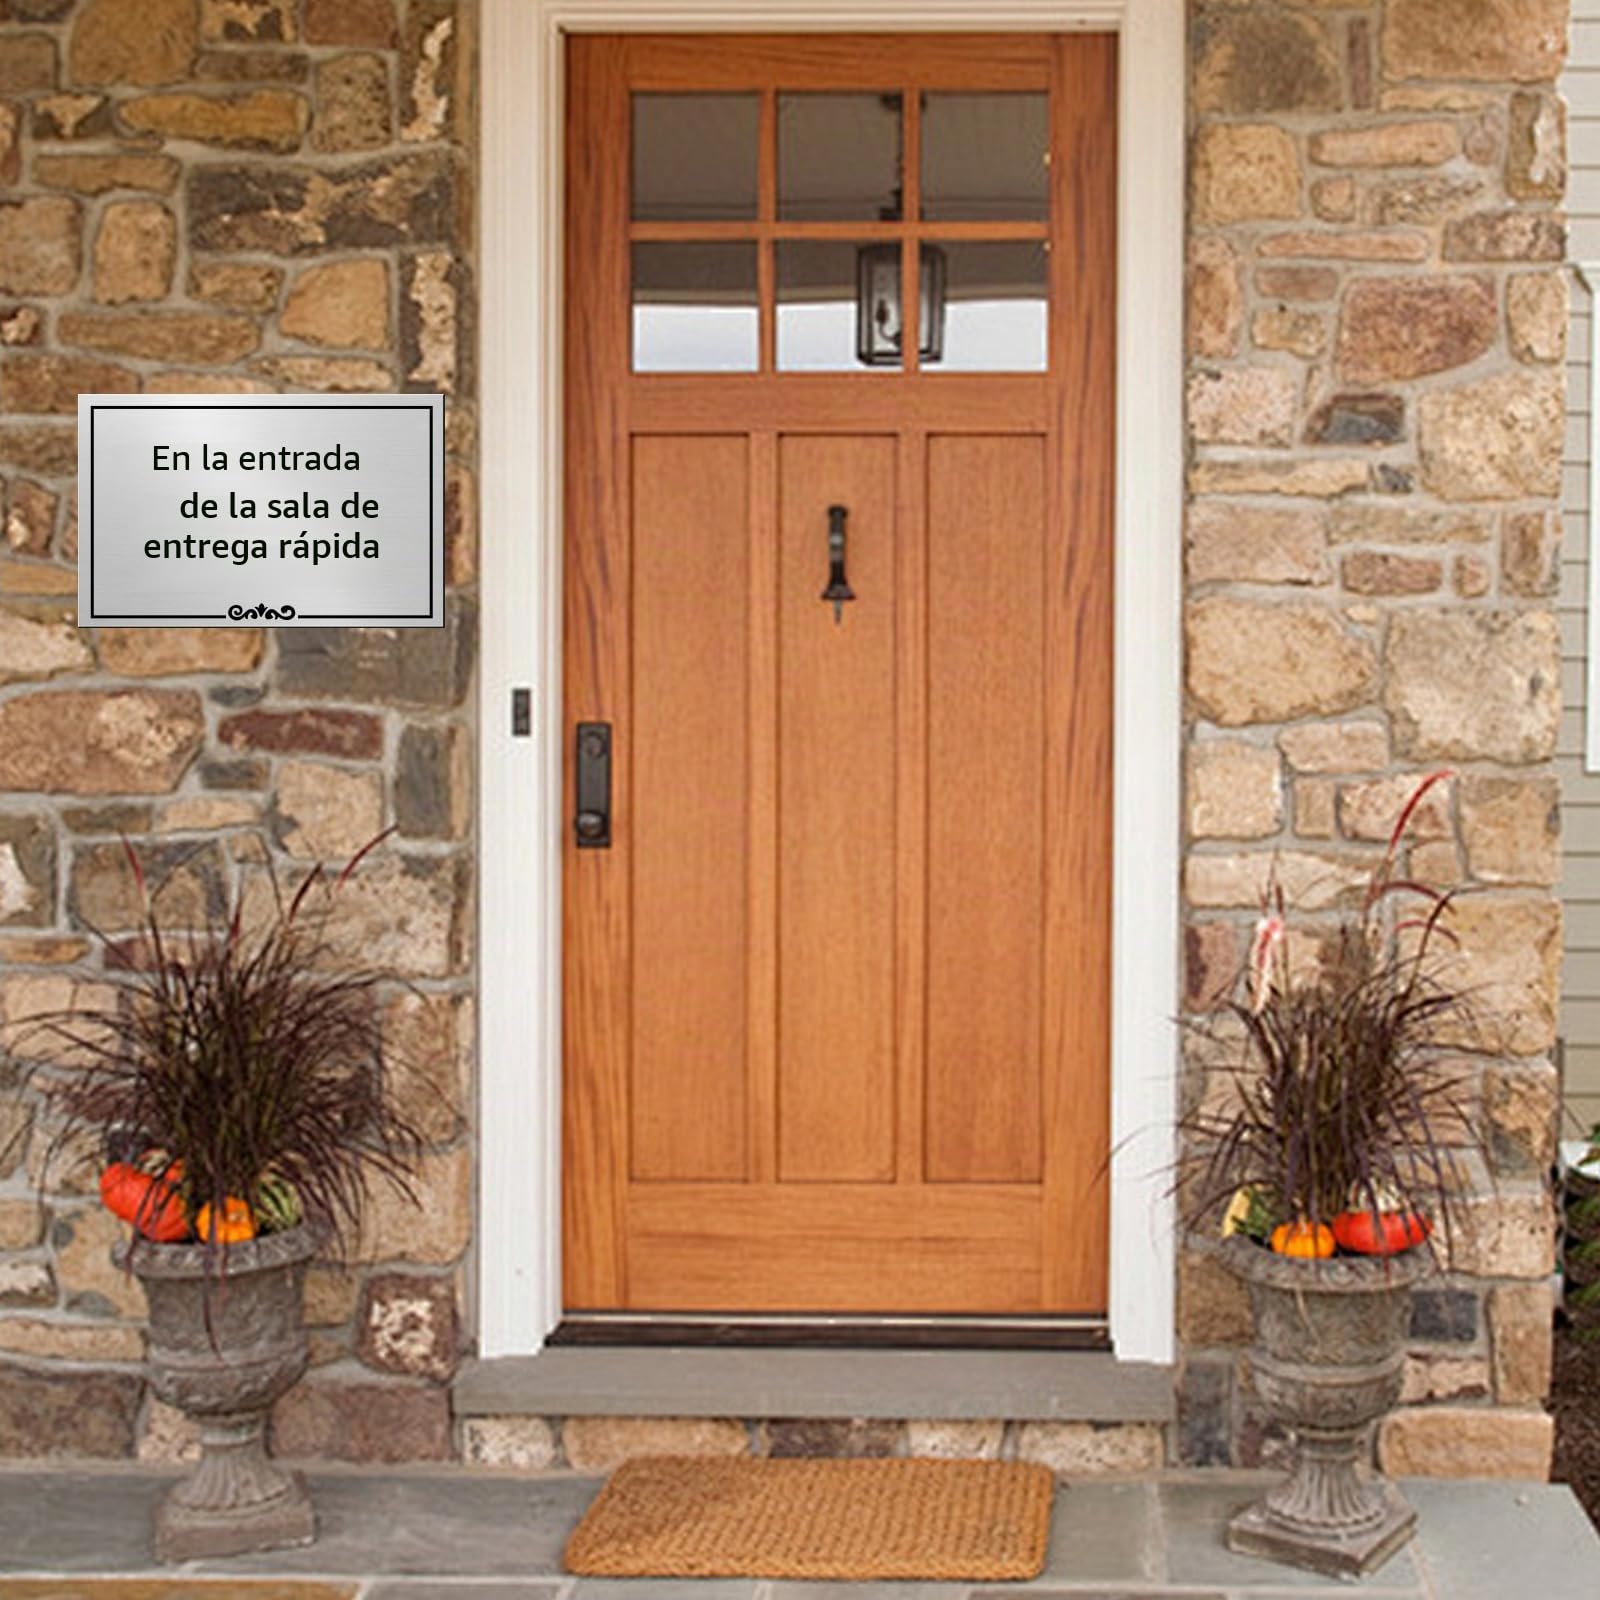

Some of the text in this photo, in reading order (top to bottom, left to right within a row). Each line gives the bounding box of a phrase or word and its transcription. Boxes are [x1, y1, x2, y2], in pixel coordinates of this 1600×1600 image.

[153, 443, 359, 470] En la entrada
[180, 491, 378, 518] de la sala de
[143, 530, 378, 565] entrega rápida
